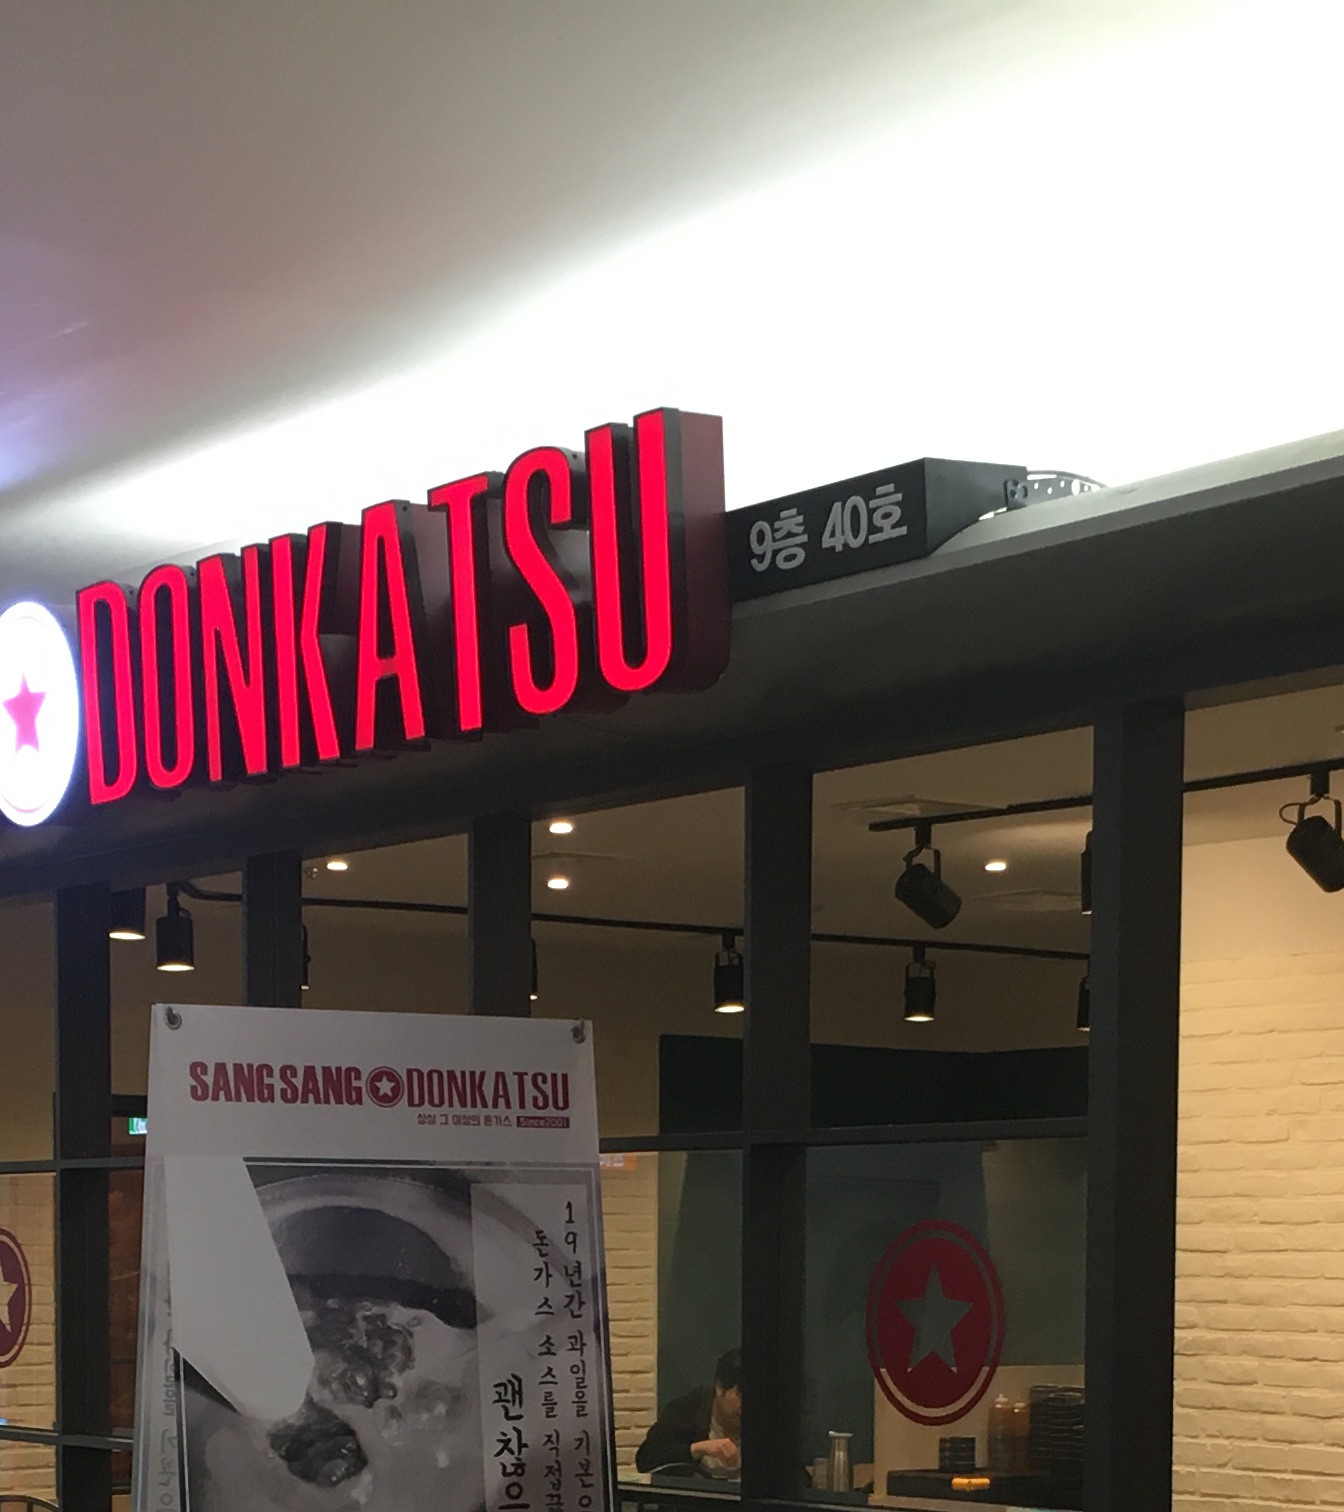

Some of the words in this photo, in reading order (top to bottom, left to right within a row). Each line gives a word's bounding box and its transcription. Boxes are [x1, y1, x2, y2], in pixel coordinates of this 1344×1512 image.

[750, 508, 808, 572] 9층
[822, 483, 907, 552] 40호
[76, 408, 674, 804] DONKATSU
[405, 1068, 569, 1111] DONKATSU
[532, 1229, 555, 1316] 돈가스
[563, 1200, 586, 1319] 19년간
[537, 1334, 559, 1419] 소스를
[566, 1329, 589, 1418] 과일을
